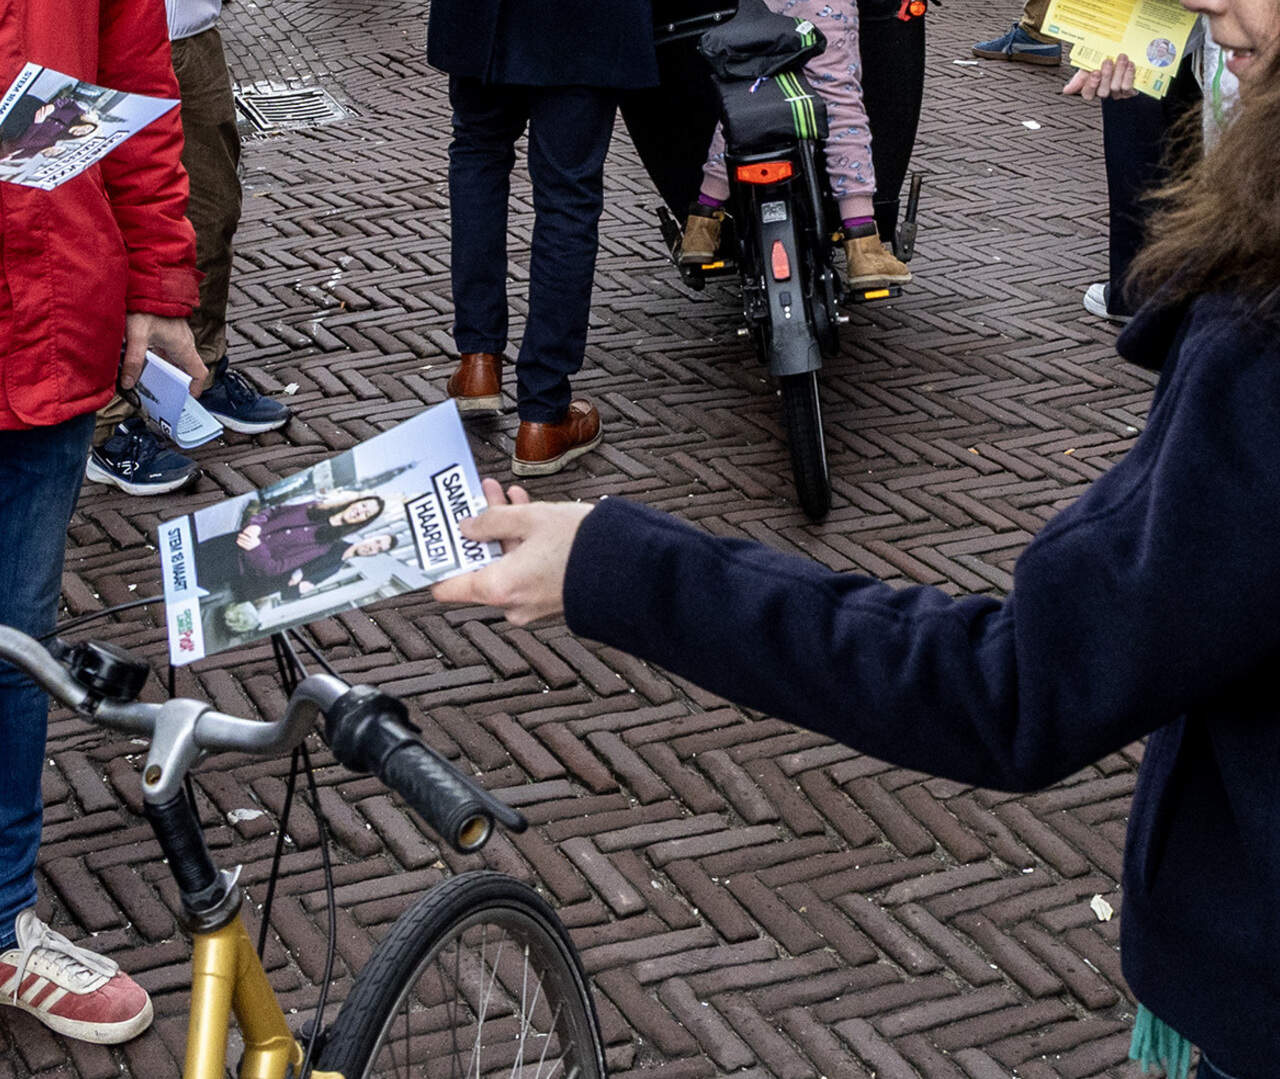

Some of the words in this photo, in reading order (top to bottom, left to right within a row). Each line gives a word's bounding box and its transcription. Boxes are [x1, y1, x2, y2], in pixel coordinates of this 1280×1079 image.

[12, 70, 33, 95] STEM
[442, 472, 472, 525] SAME
[168, 527, 182, 551] STEM
[172, 562, 188, 592] MAART
